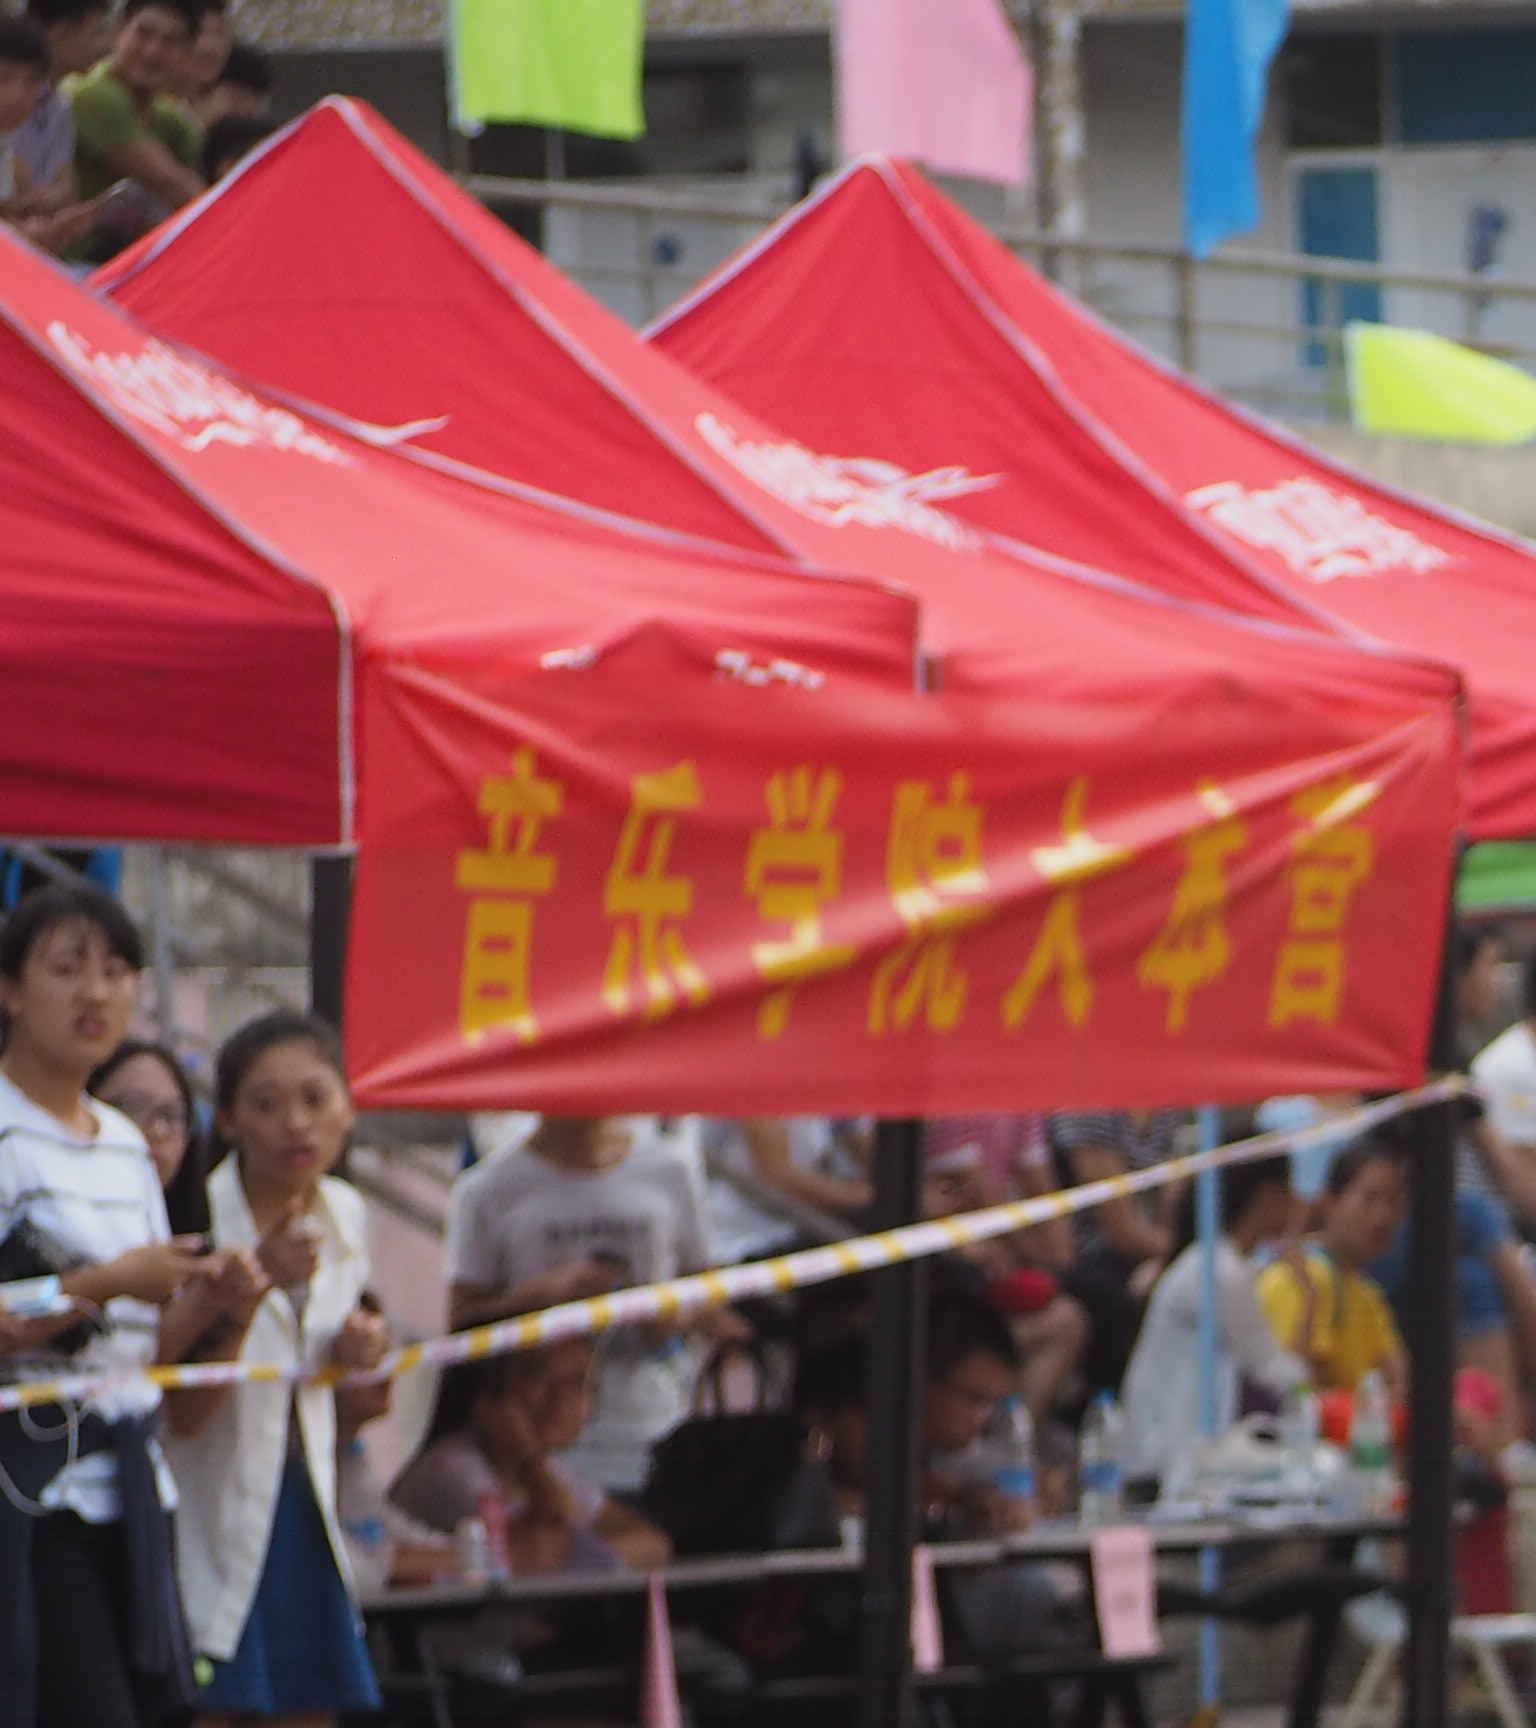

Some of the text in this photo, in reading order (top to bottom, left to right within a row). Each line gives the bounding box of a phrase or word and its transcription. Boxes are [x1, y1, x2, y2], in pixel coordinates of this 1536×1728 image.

[455, 746, 1380, 1044] 音乐学院大本营
